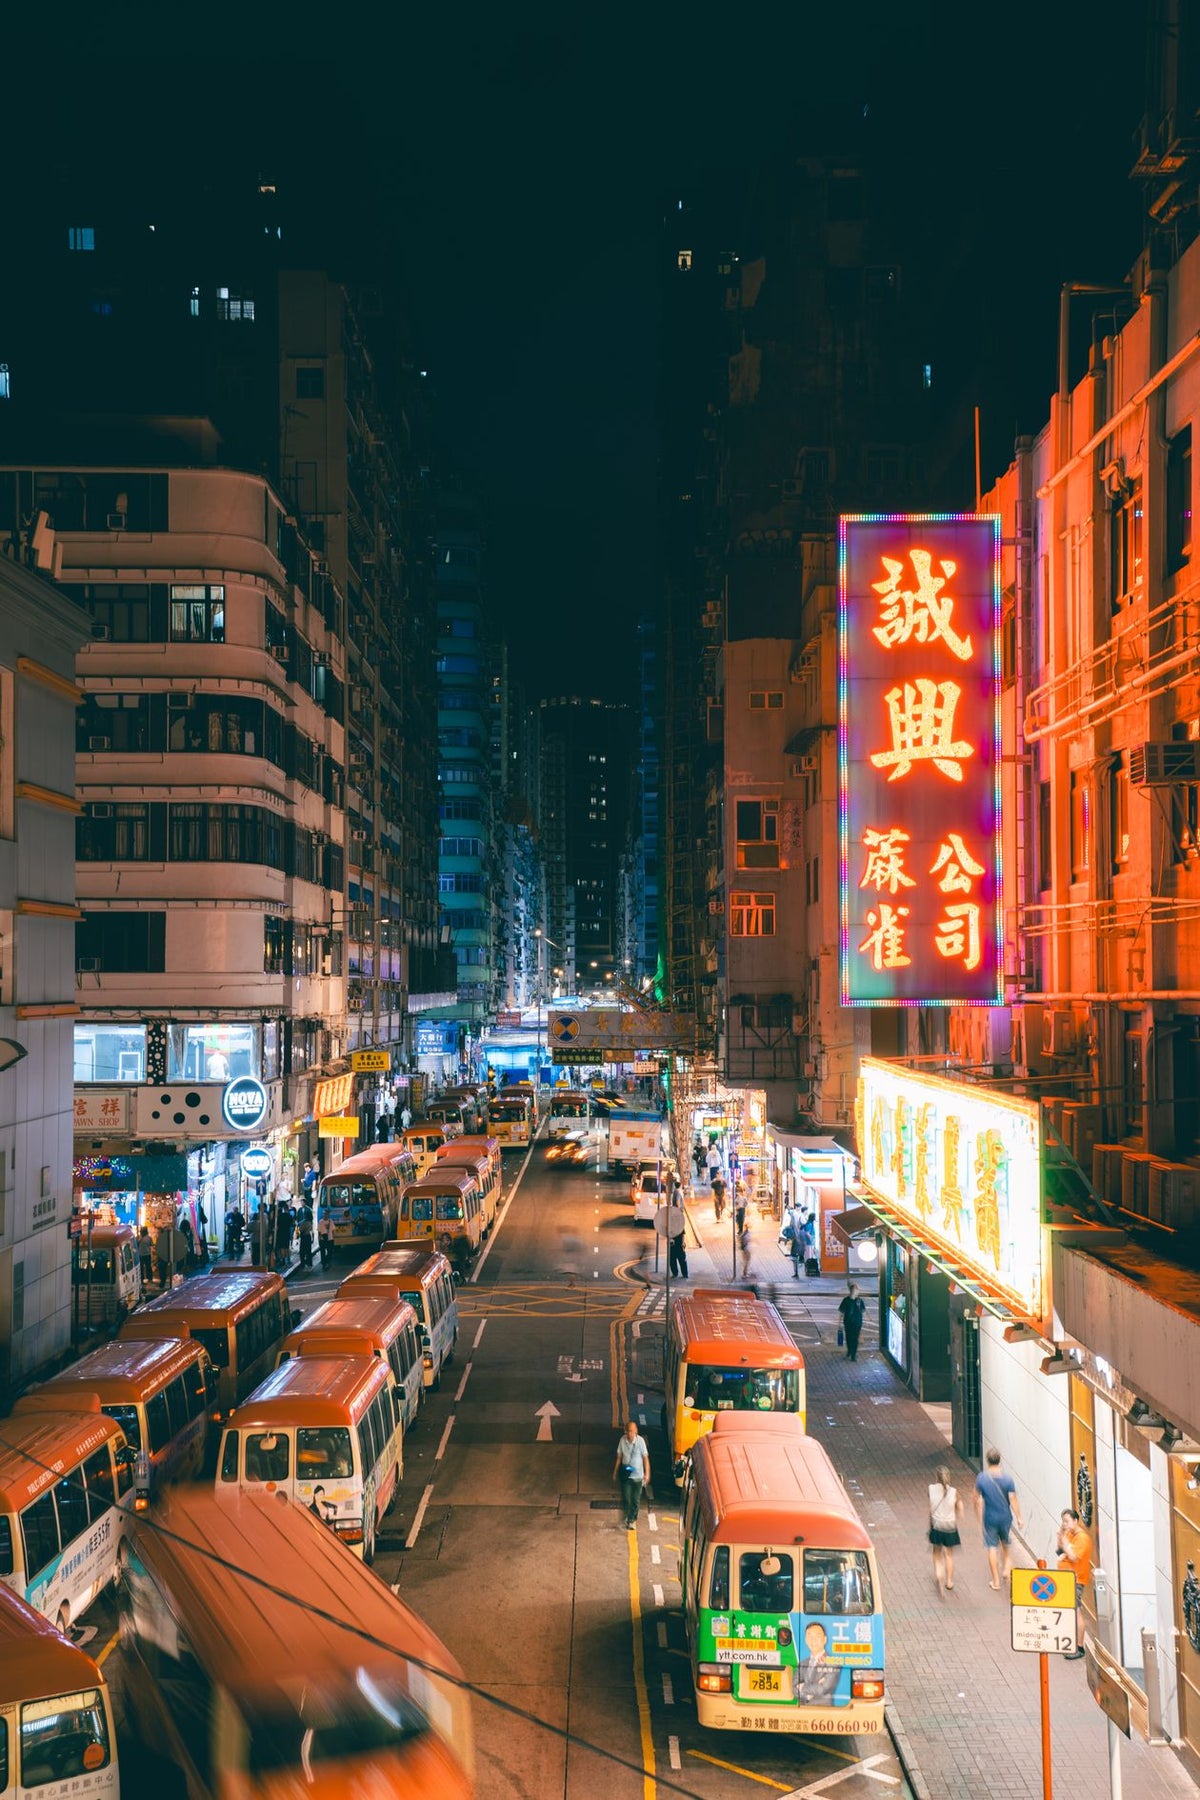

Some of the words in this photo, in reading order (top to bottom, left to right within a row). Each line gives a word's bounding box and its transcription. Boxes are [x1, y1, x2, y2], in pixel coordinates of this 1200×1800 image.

[870, 549, 975, 783] 誠興
[929, 832, 986, 971] 公司
[229, 1091, 262, 1106] NOVA
[98, 1118, 120, 1127] SHOP
[1052, 1611, 1062, 1625] 7
[1054, 1636, 1072, 1650] 12
[719, 1651, 768, 1661] ytt.com.hk
[811, 1718, 834, 1732] 660
[837, 1719, 860, 1733] 660
[863, 1720, 877, 1733] 90
